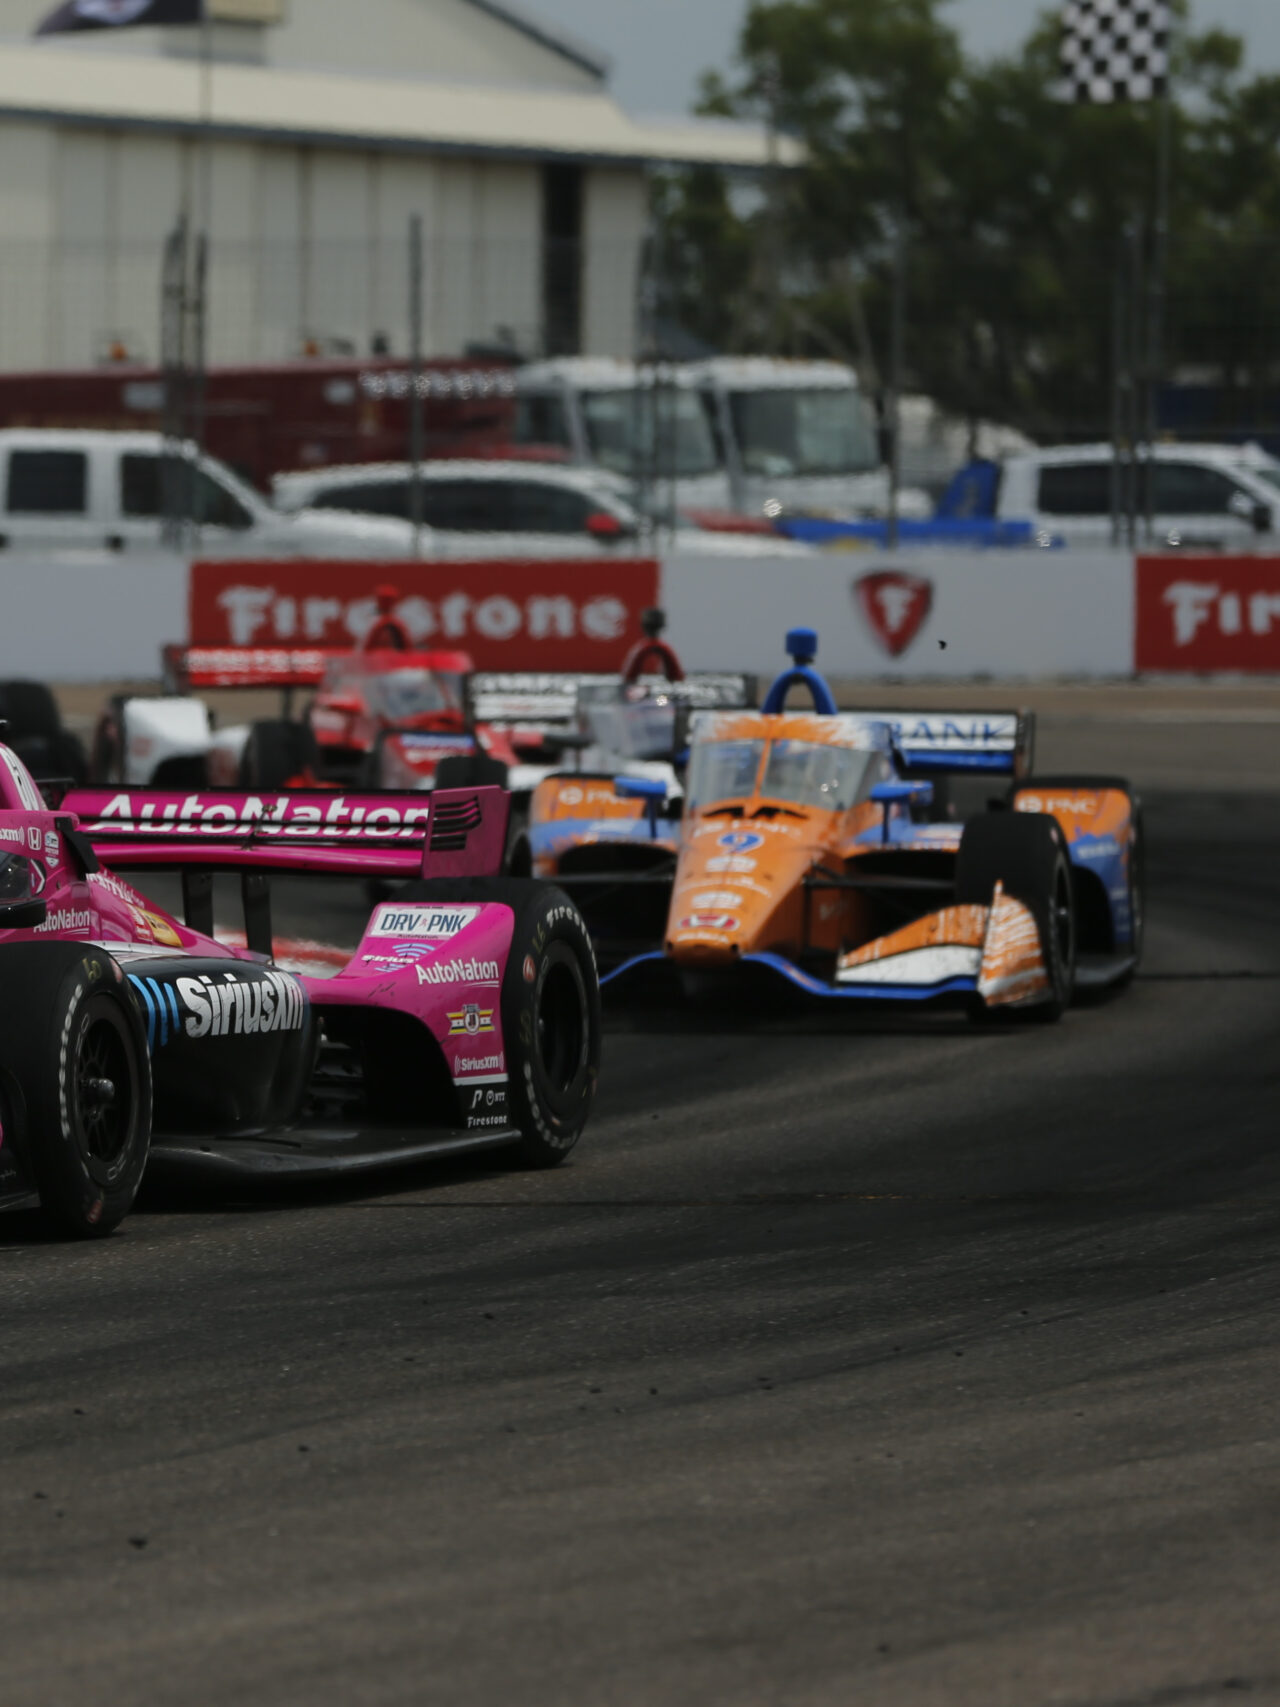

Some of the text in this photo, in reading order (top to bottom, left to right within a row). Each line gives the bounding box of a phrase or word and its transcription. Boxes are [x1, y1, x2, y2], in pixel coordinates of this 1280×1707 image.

[219, 585, 627, 646] Firestone
[86, 794, 428, 837] AutoNation
[380, 913, 467, 933] DRV PNK
[414, 957, 500, 986] AutoNation
[467, 1115, 508, 1128] Firestone
